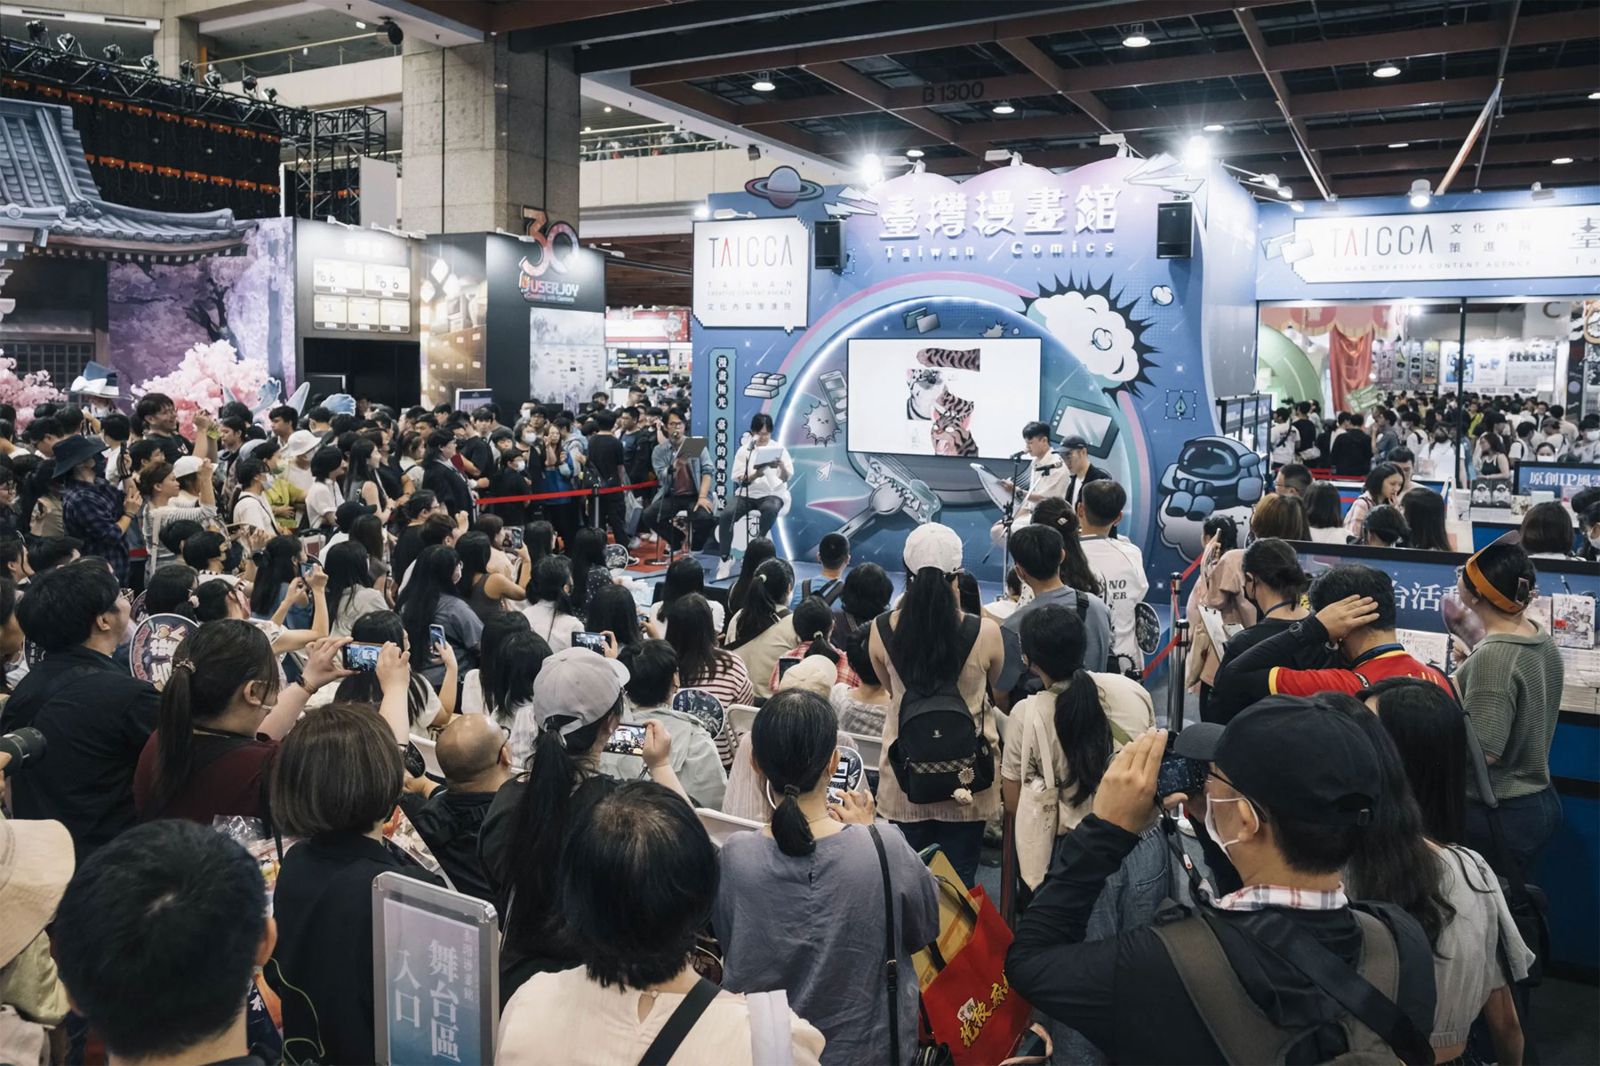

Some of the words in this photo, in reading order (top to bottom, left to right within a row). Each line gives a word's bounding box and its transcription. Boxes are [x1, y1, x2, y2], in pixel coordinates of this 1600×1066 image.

[879, 183, 1122, 241] 臺灣漫畫館
[708, 234, 793, 269] TAICCA
[886, 244, 975, 260] Taiwan
[1010, 240, 1115, 257] Comics
[1330, 224, 1434, 257] TAICCA
[530, 279, 580, 298] USERJOY
[393, 948, 422, 1028] 入口
[427, 938, 461, 1063] 舞台區
